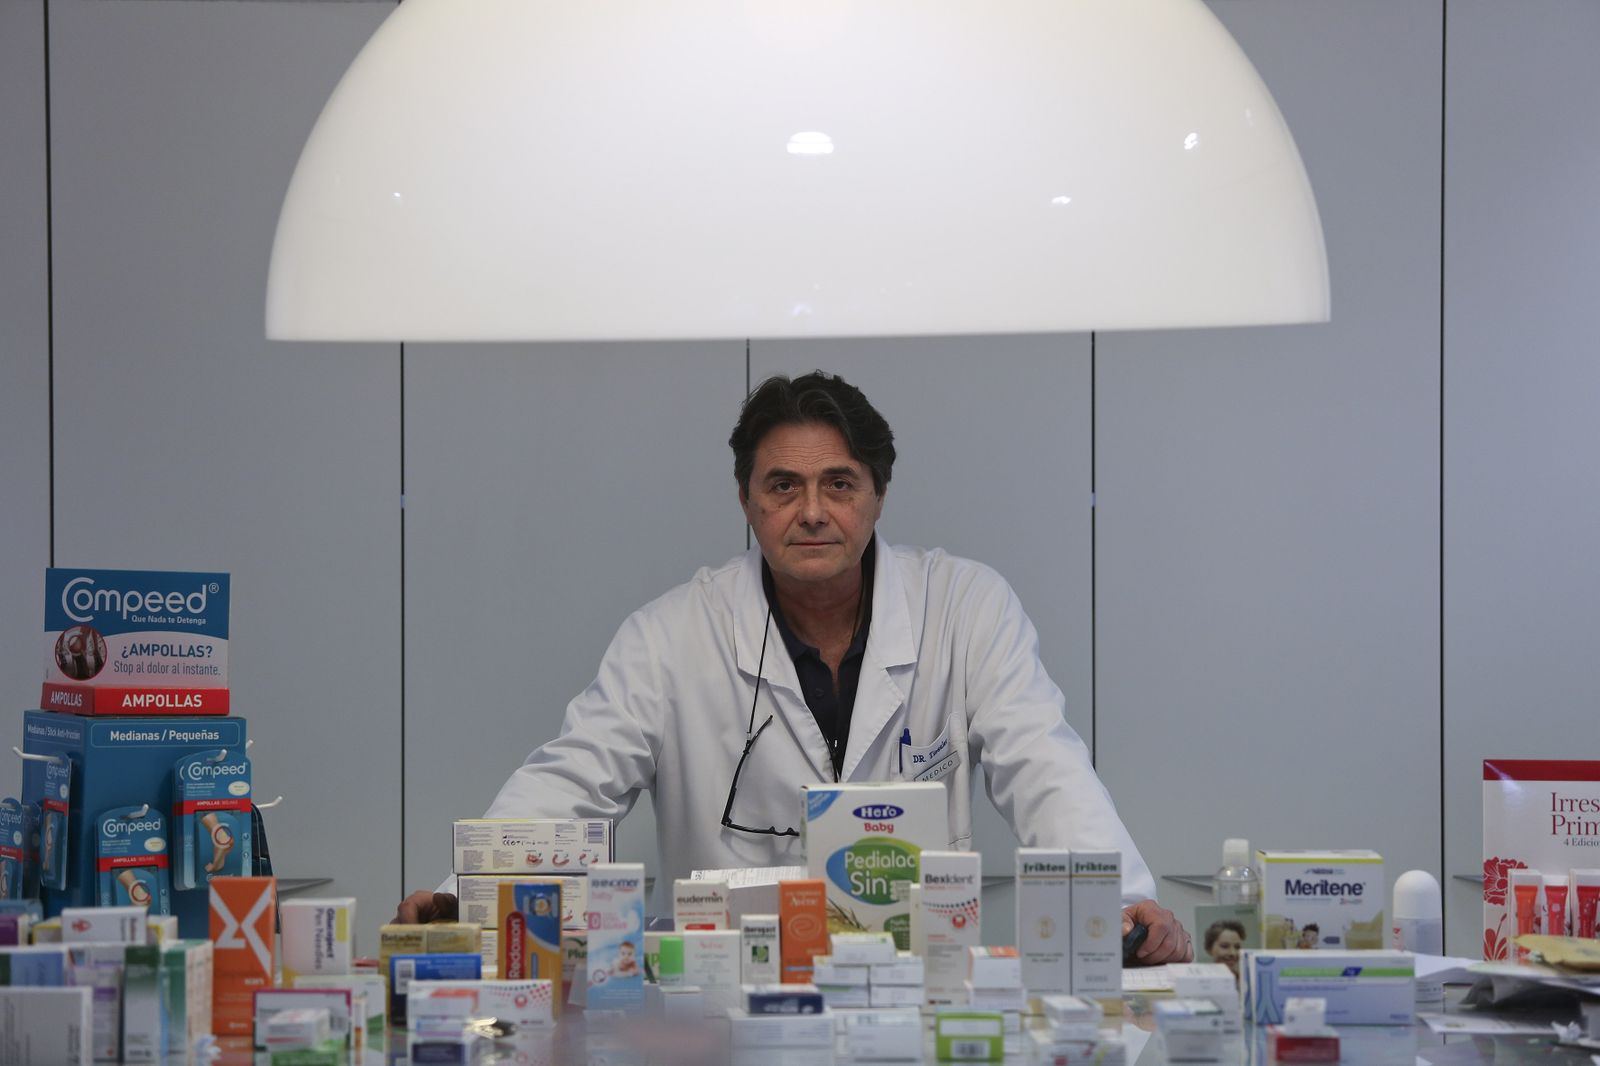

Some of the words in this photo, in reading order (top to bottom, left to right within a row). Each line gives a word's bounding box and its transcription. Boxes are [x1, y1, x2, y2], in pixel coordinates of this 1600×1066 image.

[132, 615, 146, 624] Que
[148, 615, 166, 624] Nada
[168, 616, 175, 624] te
[177, 616, 207, 625] Detenga
[121, 644, 213, 658] ¿AMPOLLAS?
[114, 661, 133, 675] Stop
[136, 662, 144, 674] al
[147, 662, 169, 675] dolor
[172, 662, 180, 675] al
[182, 663, 221, 676] instante.
[50, 690, 82, 707] AMPOLLAS
[122, 694, 202, 708] AMPOLLAS
[110, 730, 160, 742] Medianas
[161, 730, 167, 742] /
[169, 729, 219, 742] Pequeñas
[188, 761, 246, 780] Compeed
[1551, 792, 1600, 813] Irres
[860, 805, 897, 818] Hero
[103, 818, 161, 837] Compeed
[864, 823, 894, 834] Baby
[1563, 838, 1569, 846] 4
[844, 852, 915, 869] Pedialac
[1023, 862, 1066, 873] frikton
[1074, 862, 1117, 873] frikton
[851, 872, 888, 896] Sin
[1285, 879, 1363, 896] Meritene
[677, 893, 723, 904] eudermin
[508, 918, 521, 980] Redoxon
